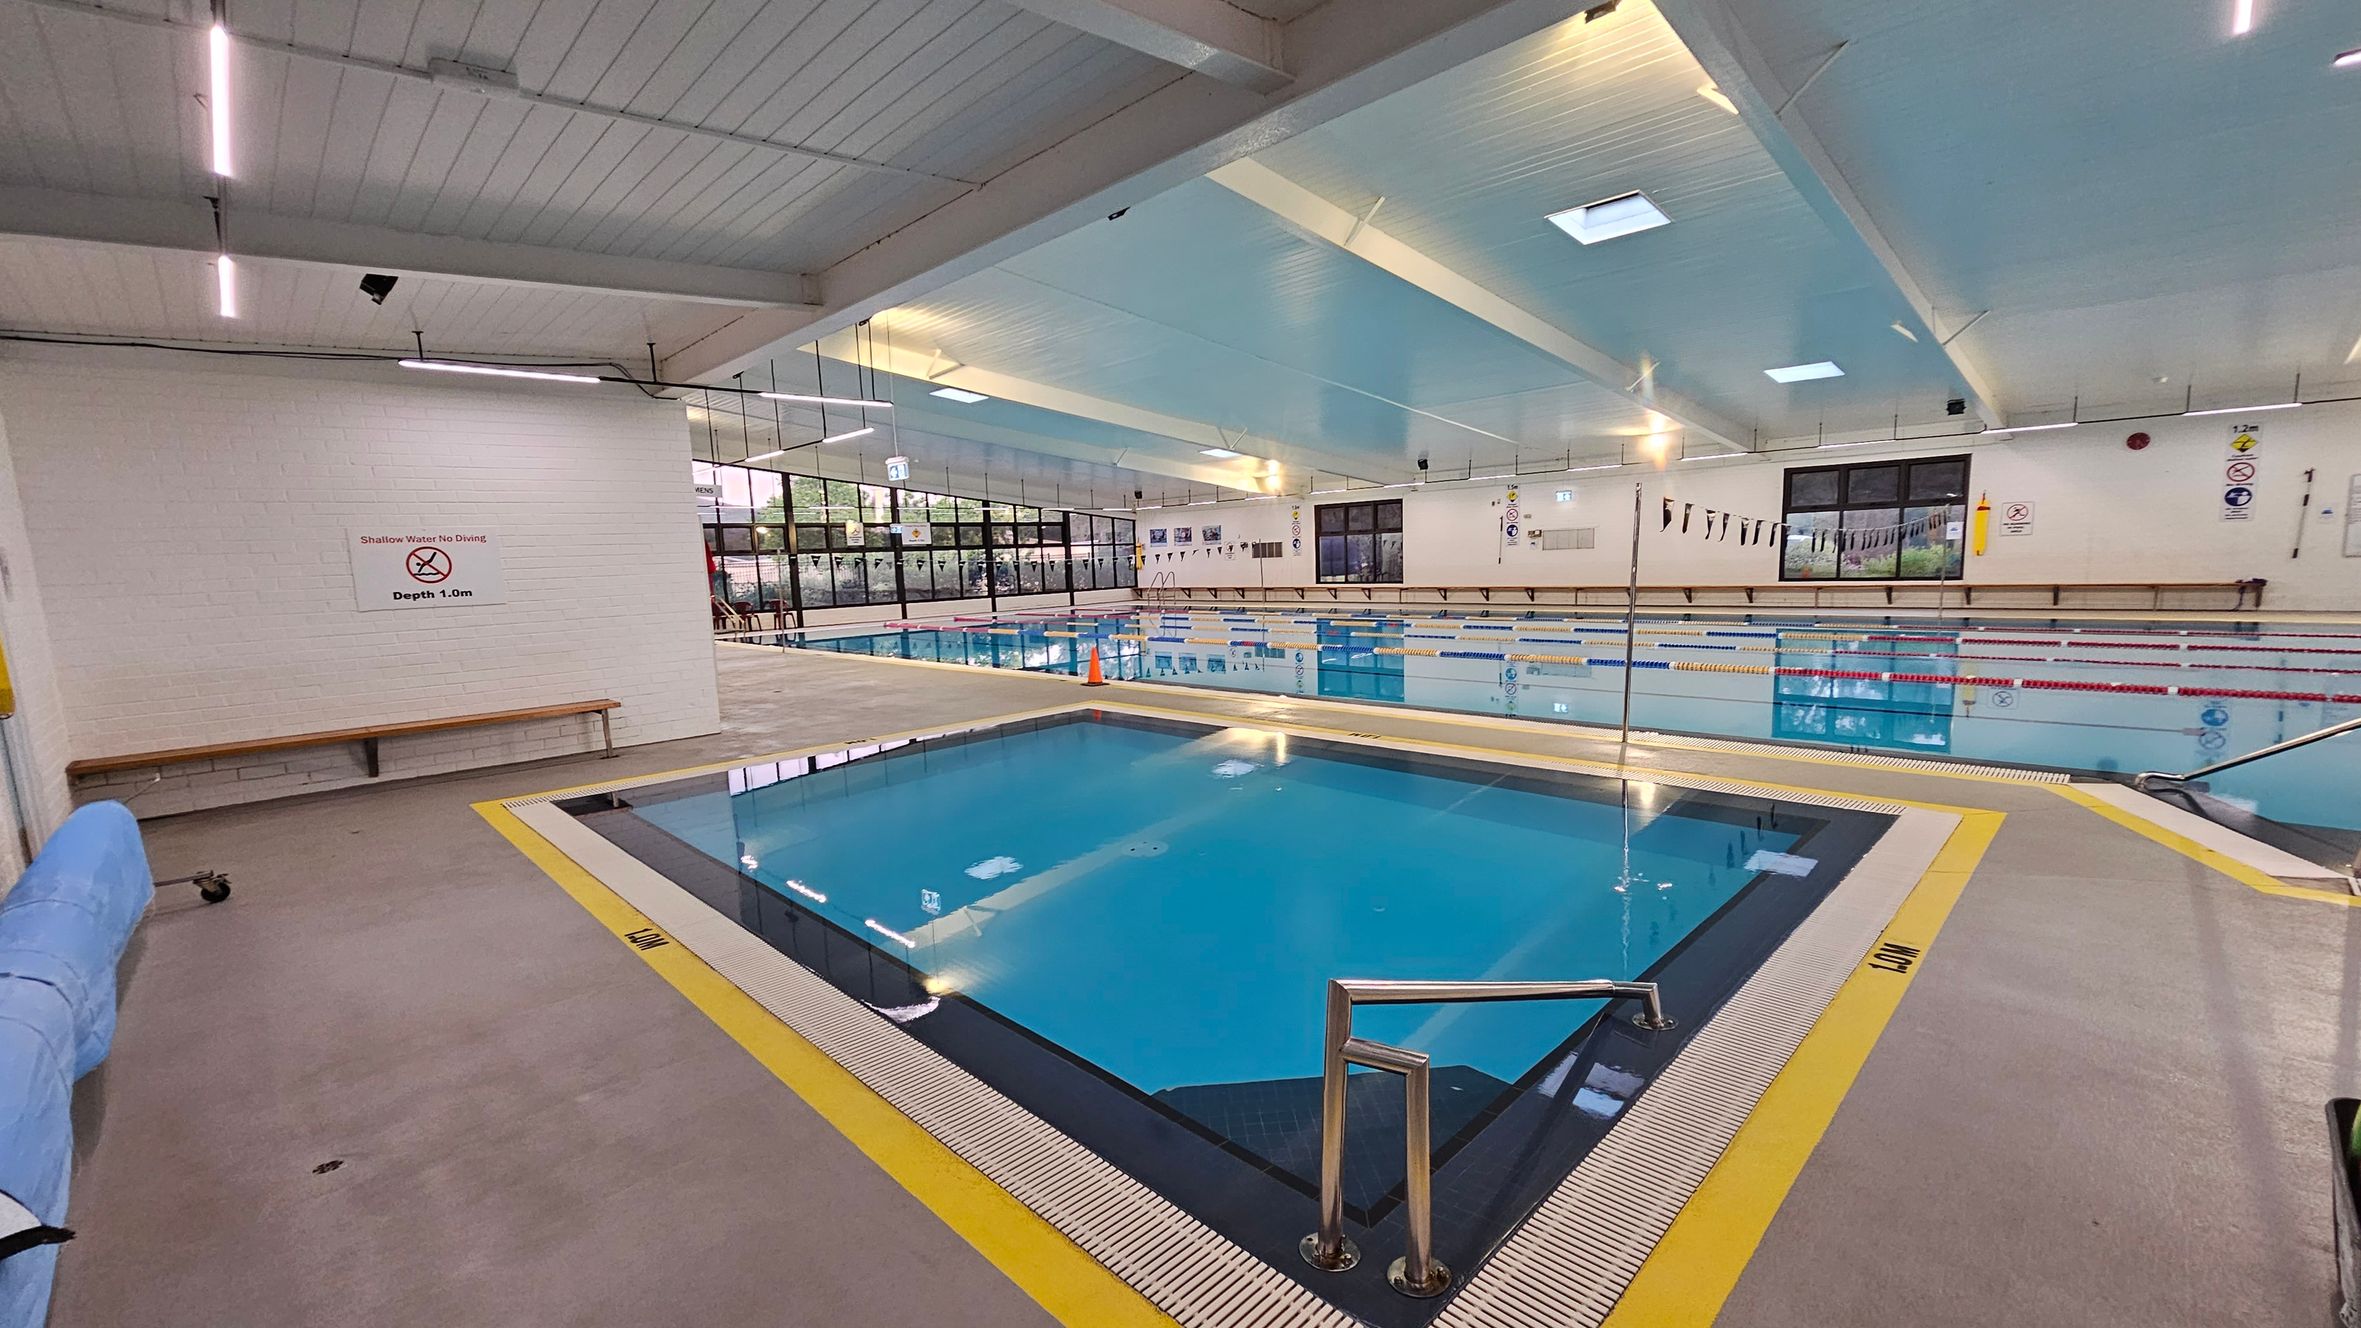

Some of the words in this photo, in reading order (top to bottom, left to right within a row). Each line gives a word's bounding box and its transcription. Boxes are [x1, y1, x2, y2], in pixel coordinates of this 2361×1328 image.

[360, 535, 404, 544] Shallow
[405, 535, 436, 543] Water
[438, 535, 453, 543] No
[455, 534, 487, 544] Diving
[393, 590, 435, 601] Depth
[439, 589, 473, 598] 1.0m
[1867, 942, 1921, 974] 1.0M
